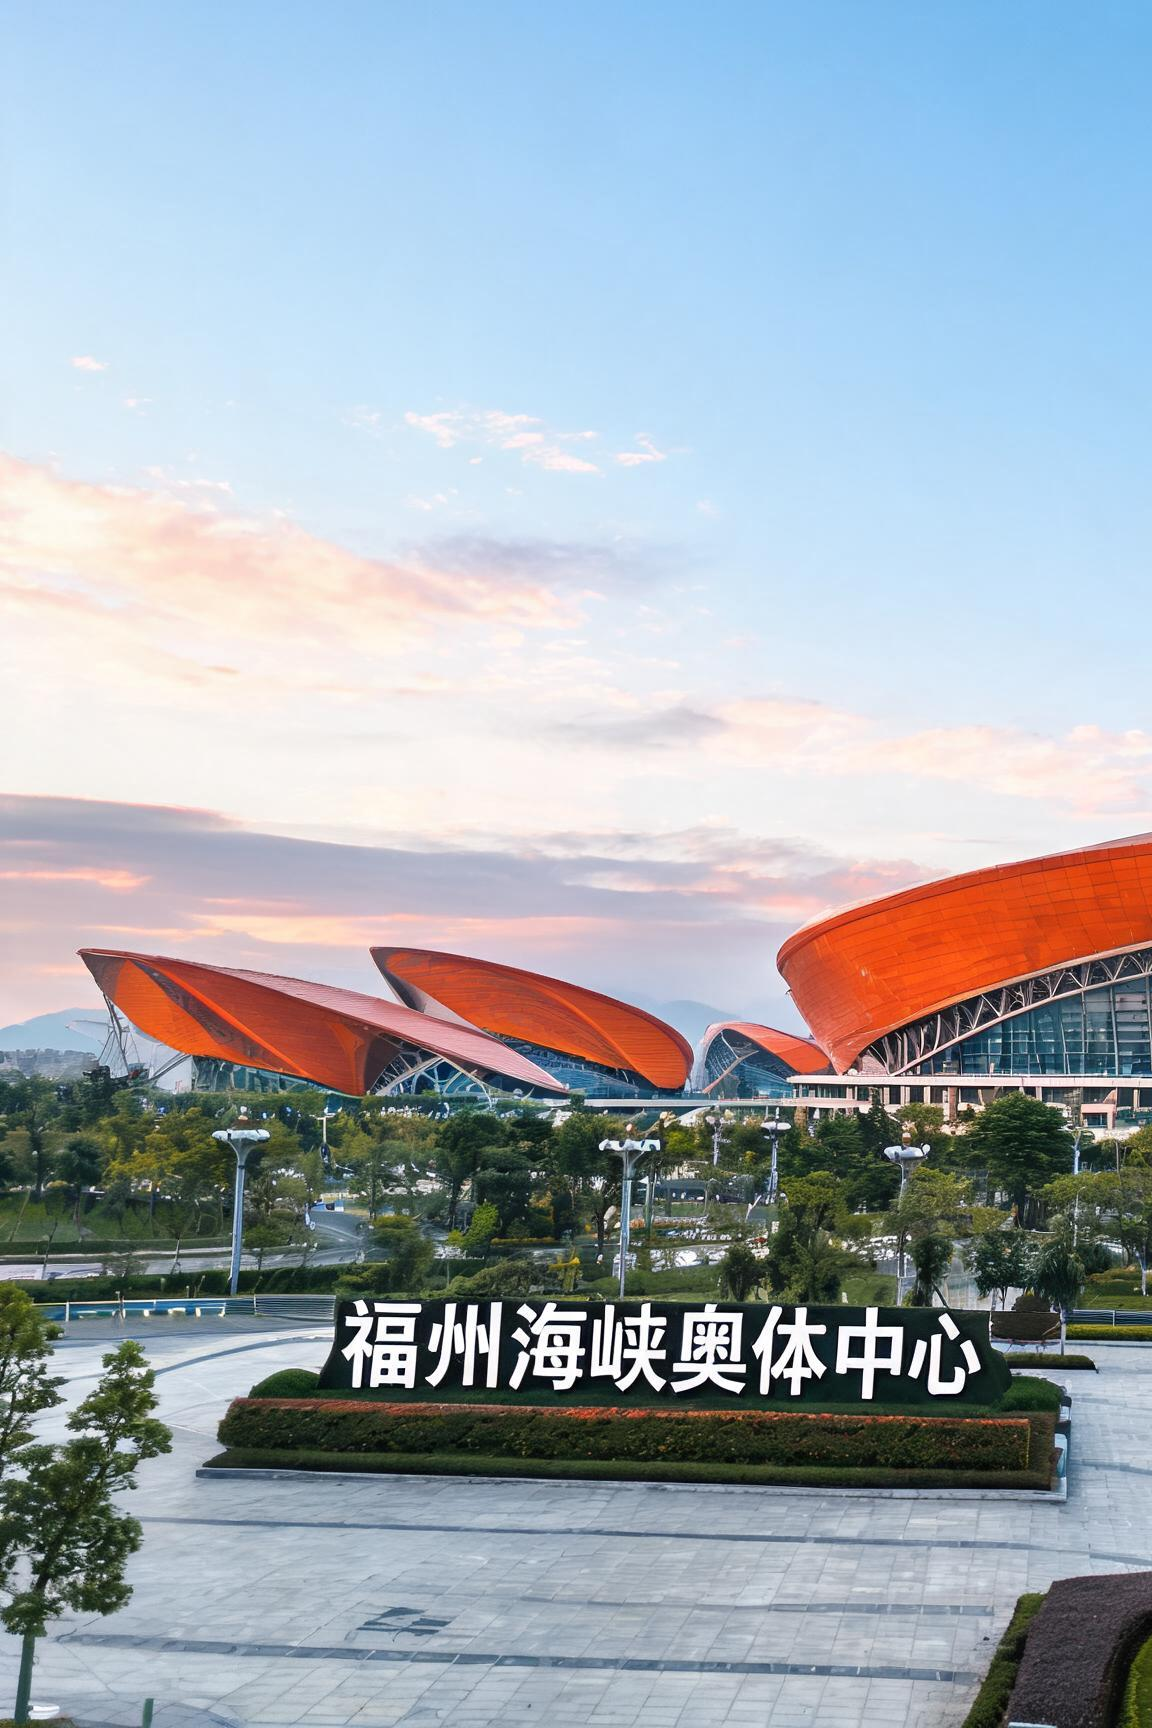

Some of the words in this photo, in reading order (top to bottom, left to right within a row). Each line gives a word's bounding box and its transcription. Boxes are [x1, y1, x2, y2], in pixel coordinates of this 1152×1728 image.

[341, 1300, 983, 1400] 福州海峡奥体中心
